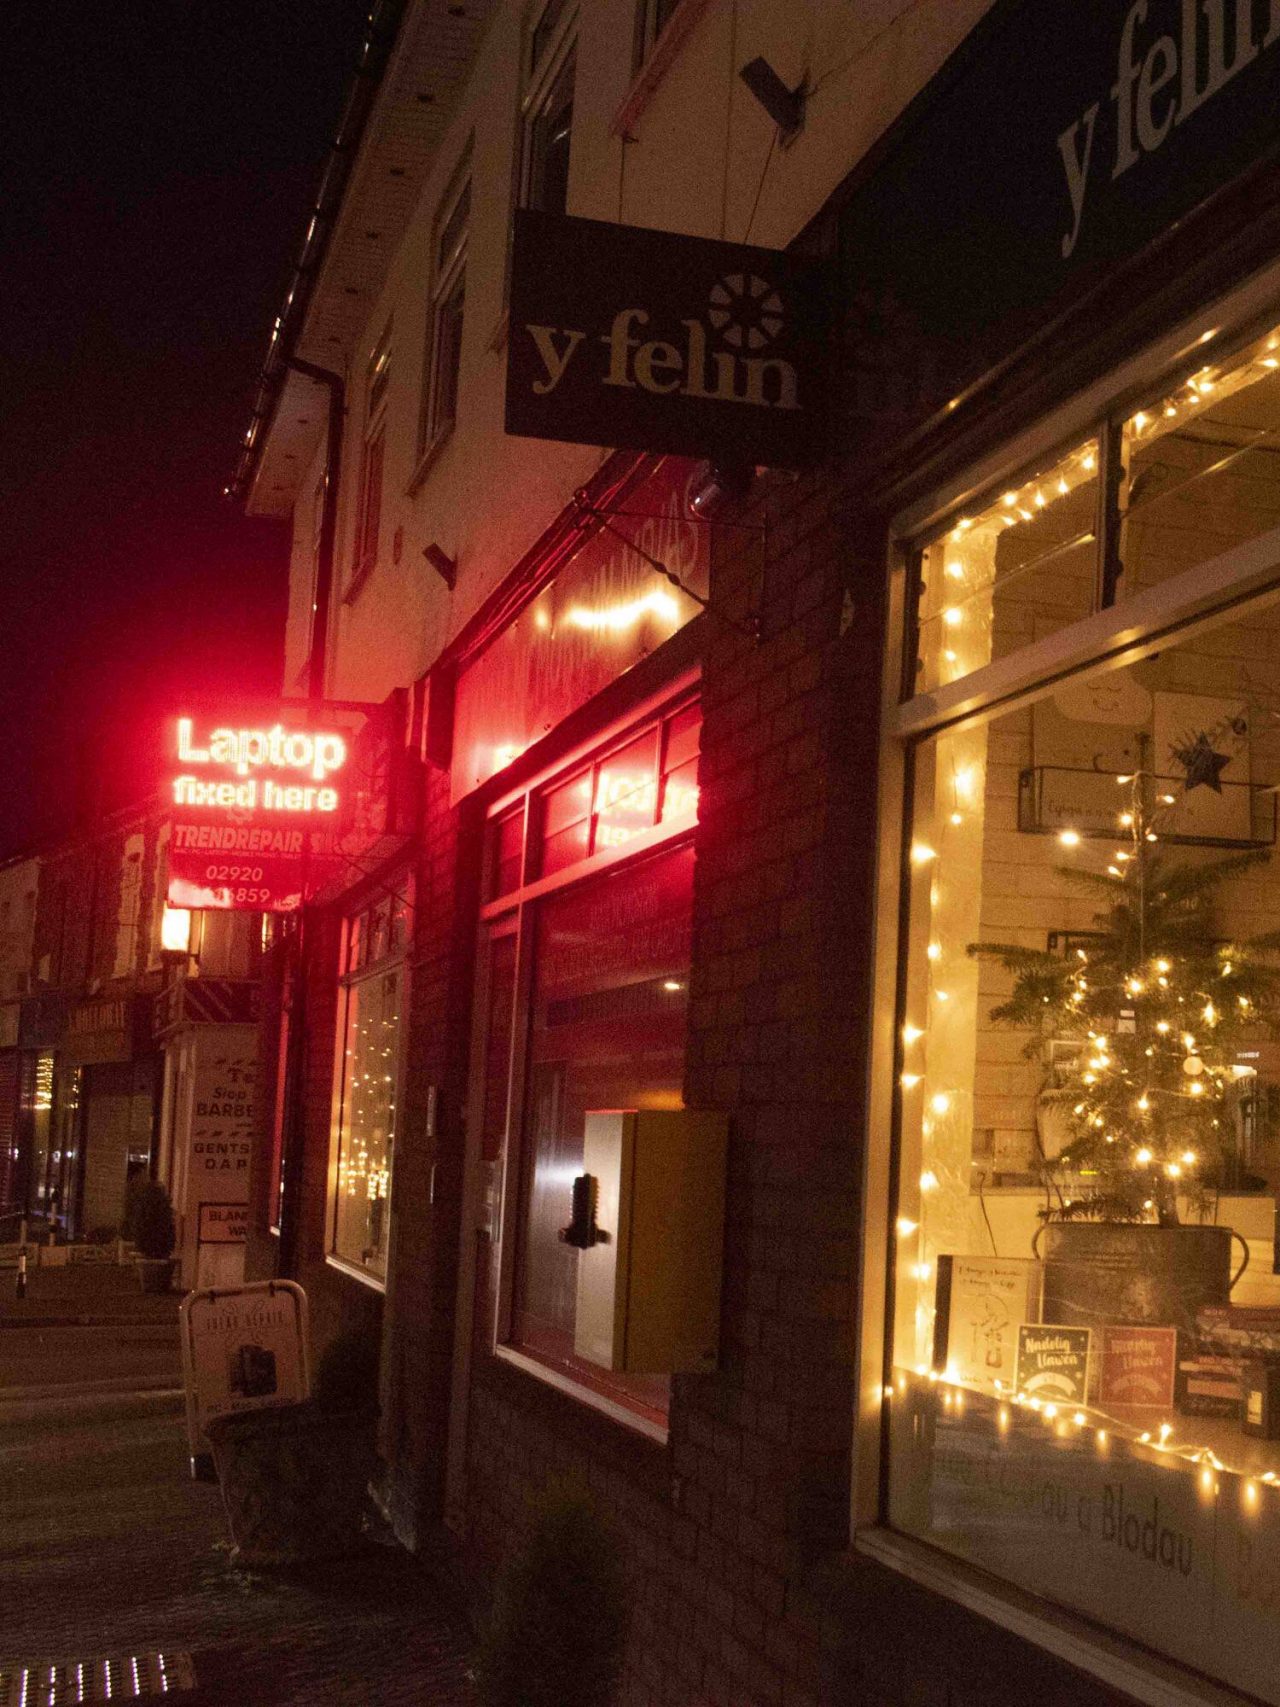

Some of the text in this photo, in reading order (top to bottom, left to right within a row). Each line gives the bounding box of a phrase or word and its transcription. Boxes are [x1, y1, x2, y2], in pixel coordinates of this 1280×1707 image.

[1057, 101, 1099, 259] y
[525, 308, 802, 410] y felin
[177, 717, 347, 780] Laptop
[172, 775, 339, 812] fixed here
[174, 824, 304, 853] TRENDREPAIR
[205, 865, 264, 882] 02920
[193, 1142, 251, 1154] GENTS
